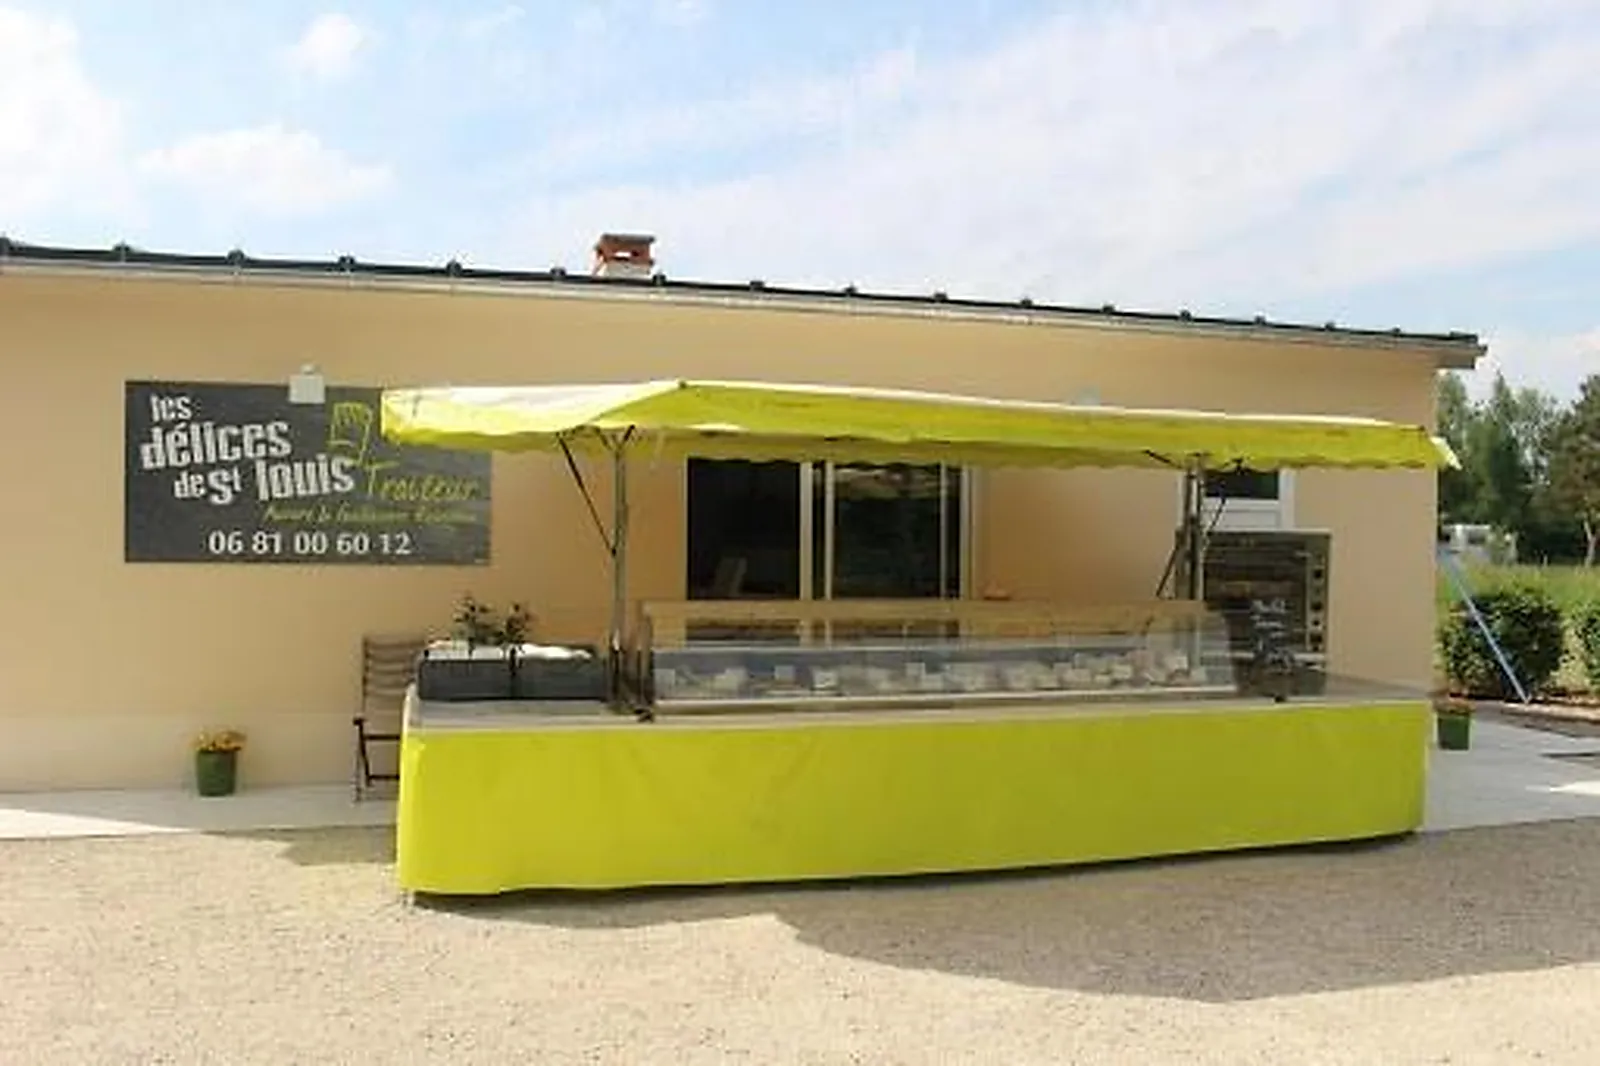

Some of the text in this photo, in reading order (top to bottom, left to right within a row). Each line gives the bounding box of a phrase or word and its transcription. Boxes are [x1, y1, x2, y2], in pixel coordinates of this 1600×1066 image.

[151, 395, 193, 421] les
[141, 421, 292, 470] délices
[174, 470, 206, 498] de
[254, 454, 355, 501] louis
[208, 529, 413, 556] 06 81 00 60 12
